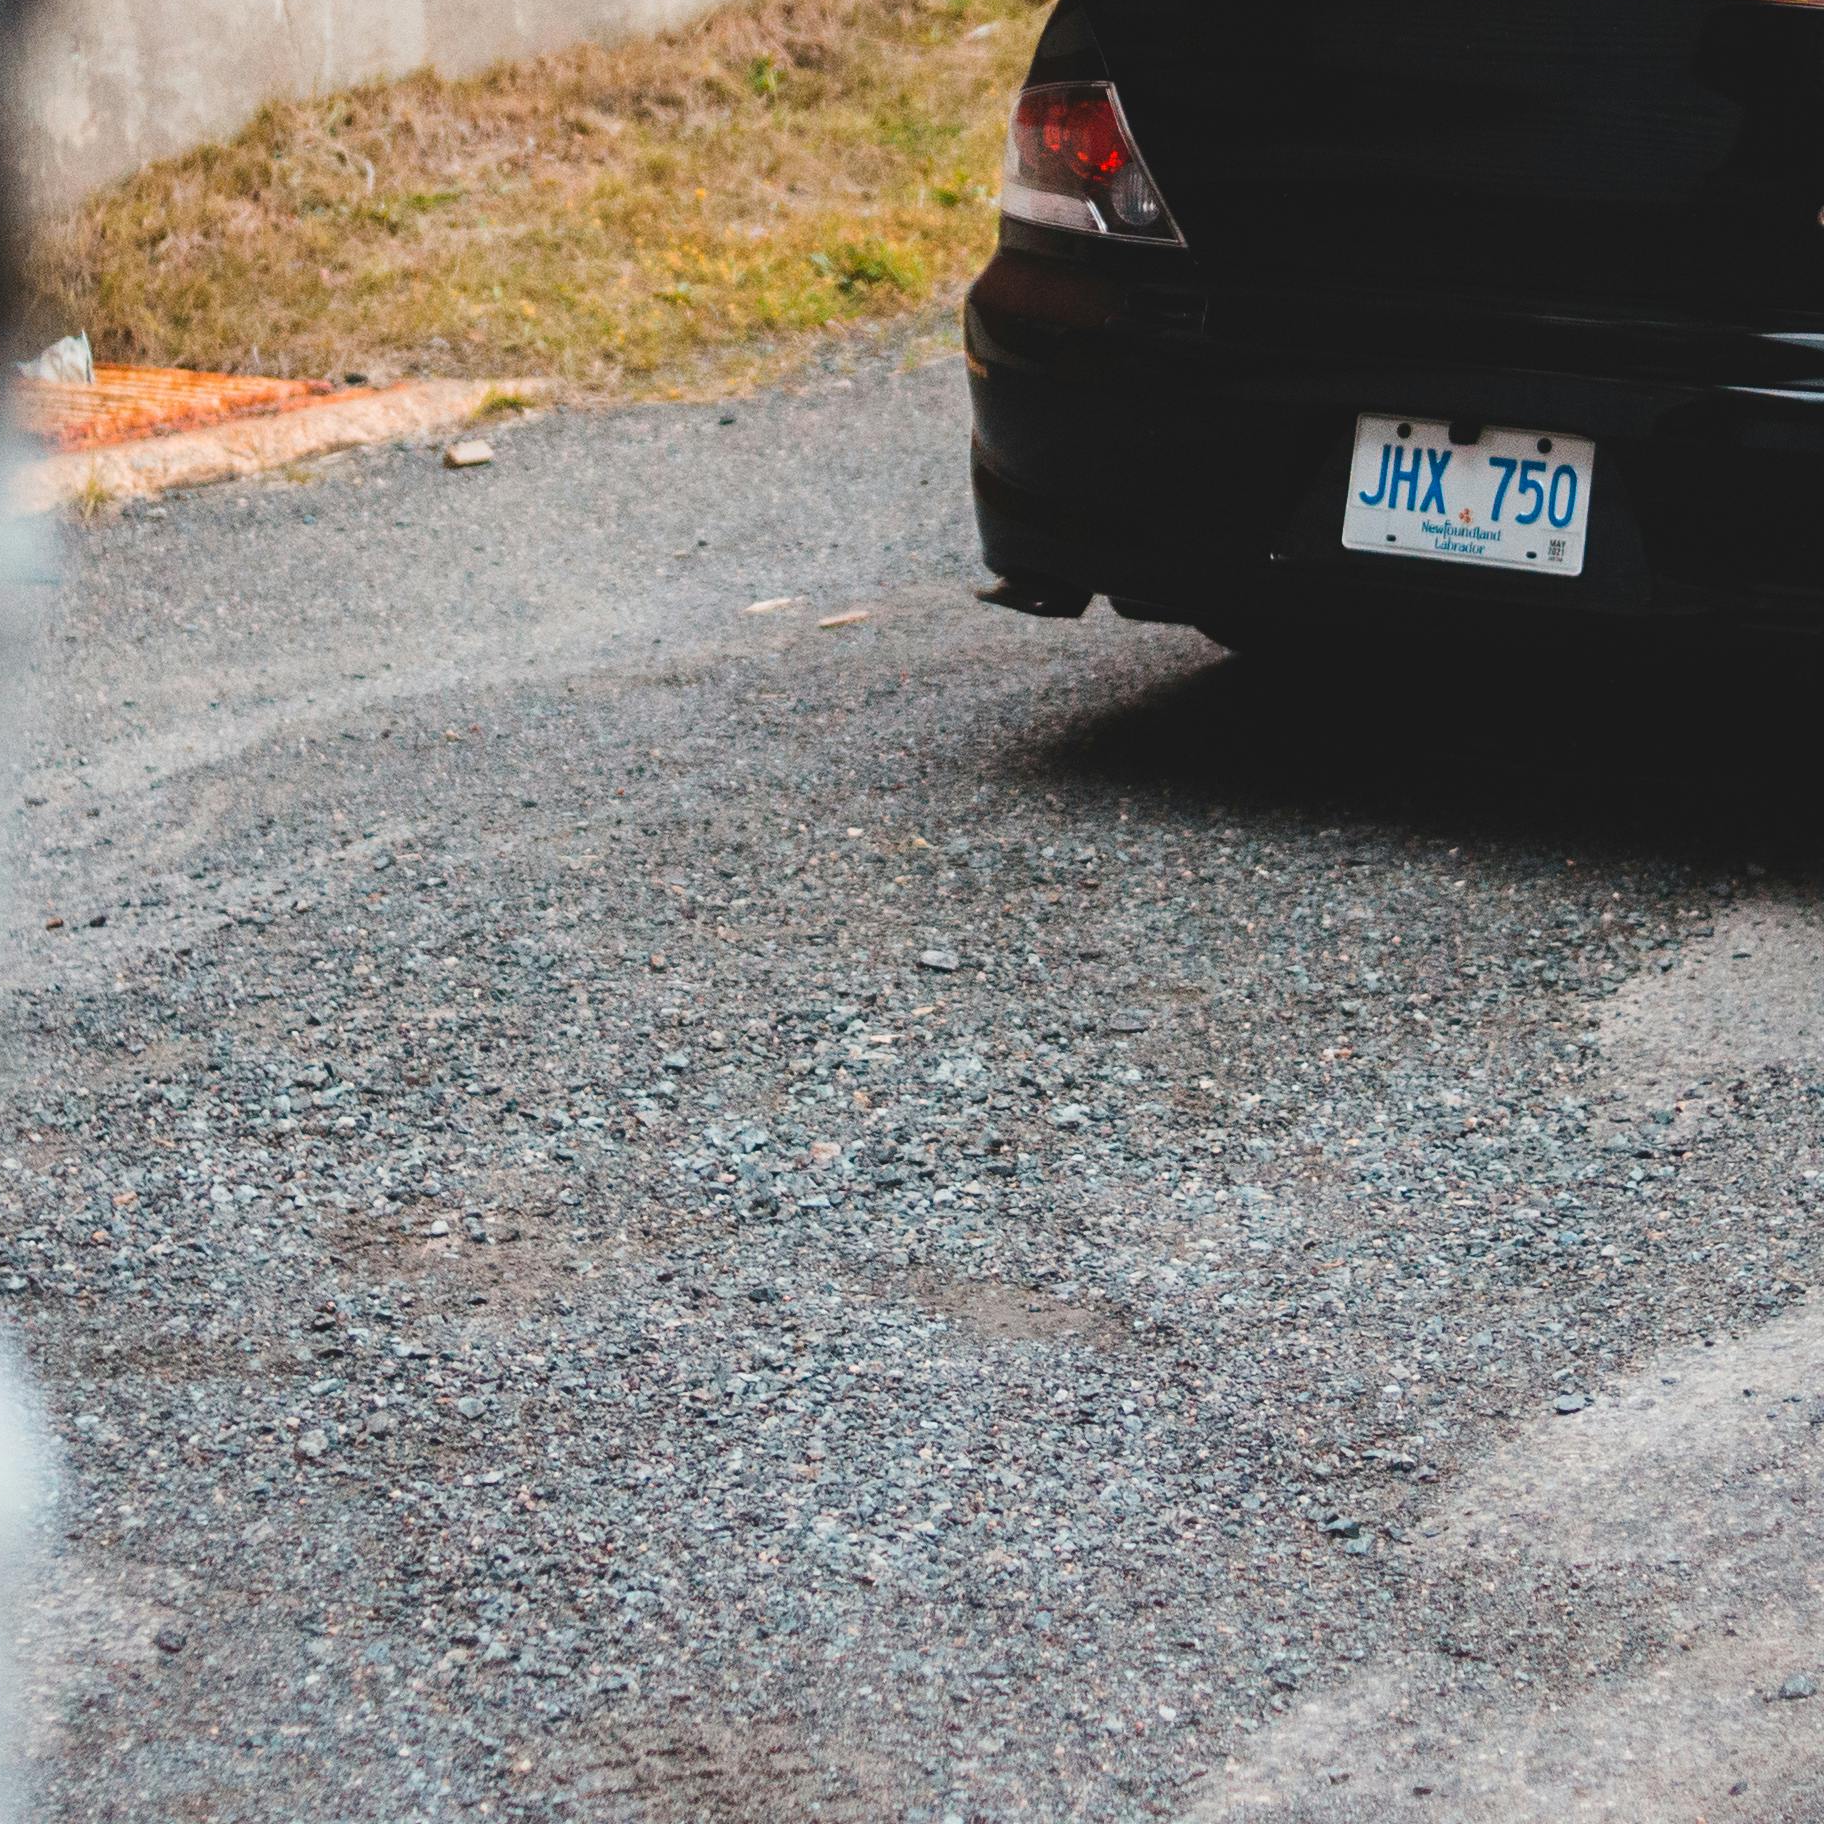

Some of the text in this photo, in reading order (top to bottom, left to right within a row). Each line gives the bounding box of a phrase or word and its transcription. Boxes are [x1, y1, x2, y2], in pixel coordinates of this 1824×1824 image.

[1359, 444, 1577, 528] JHX 750
[1421, 519, 1501, 542] Newfoundland
[1434, 536, 1485, 554] Labrador
[1550, 539, 1566, 547] MAY
